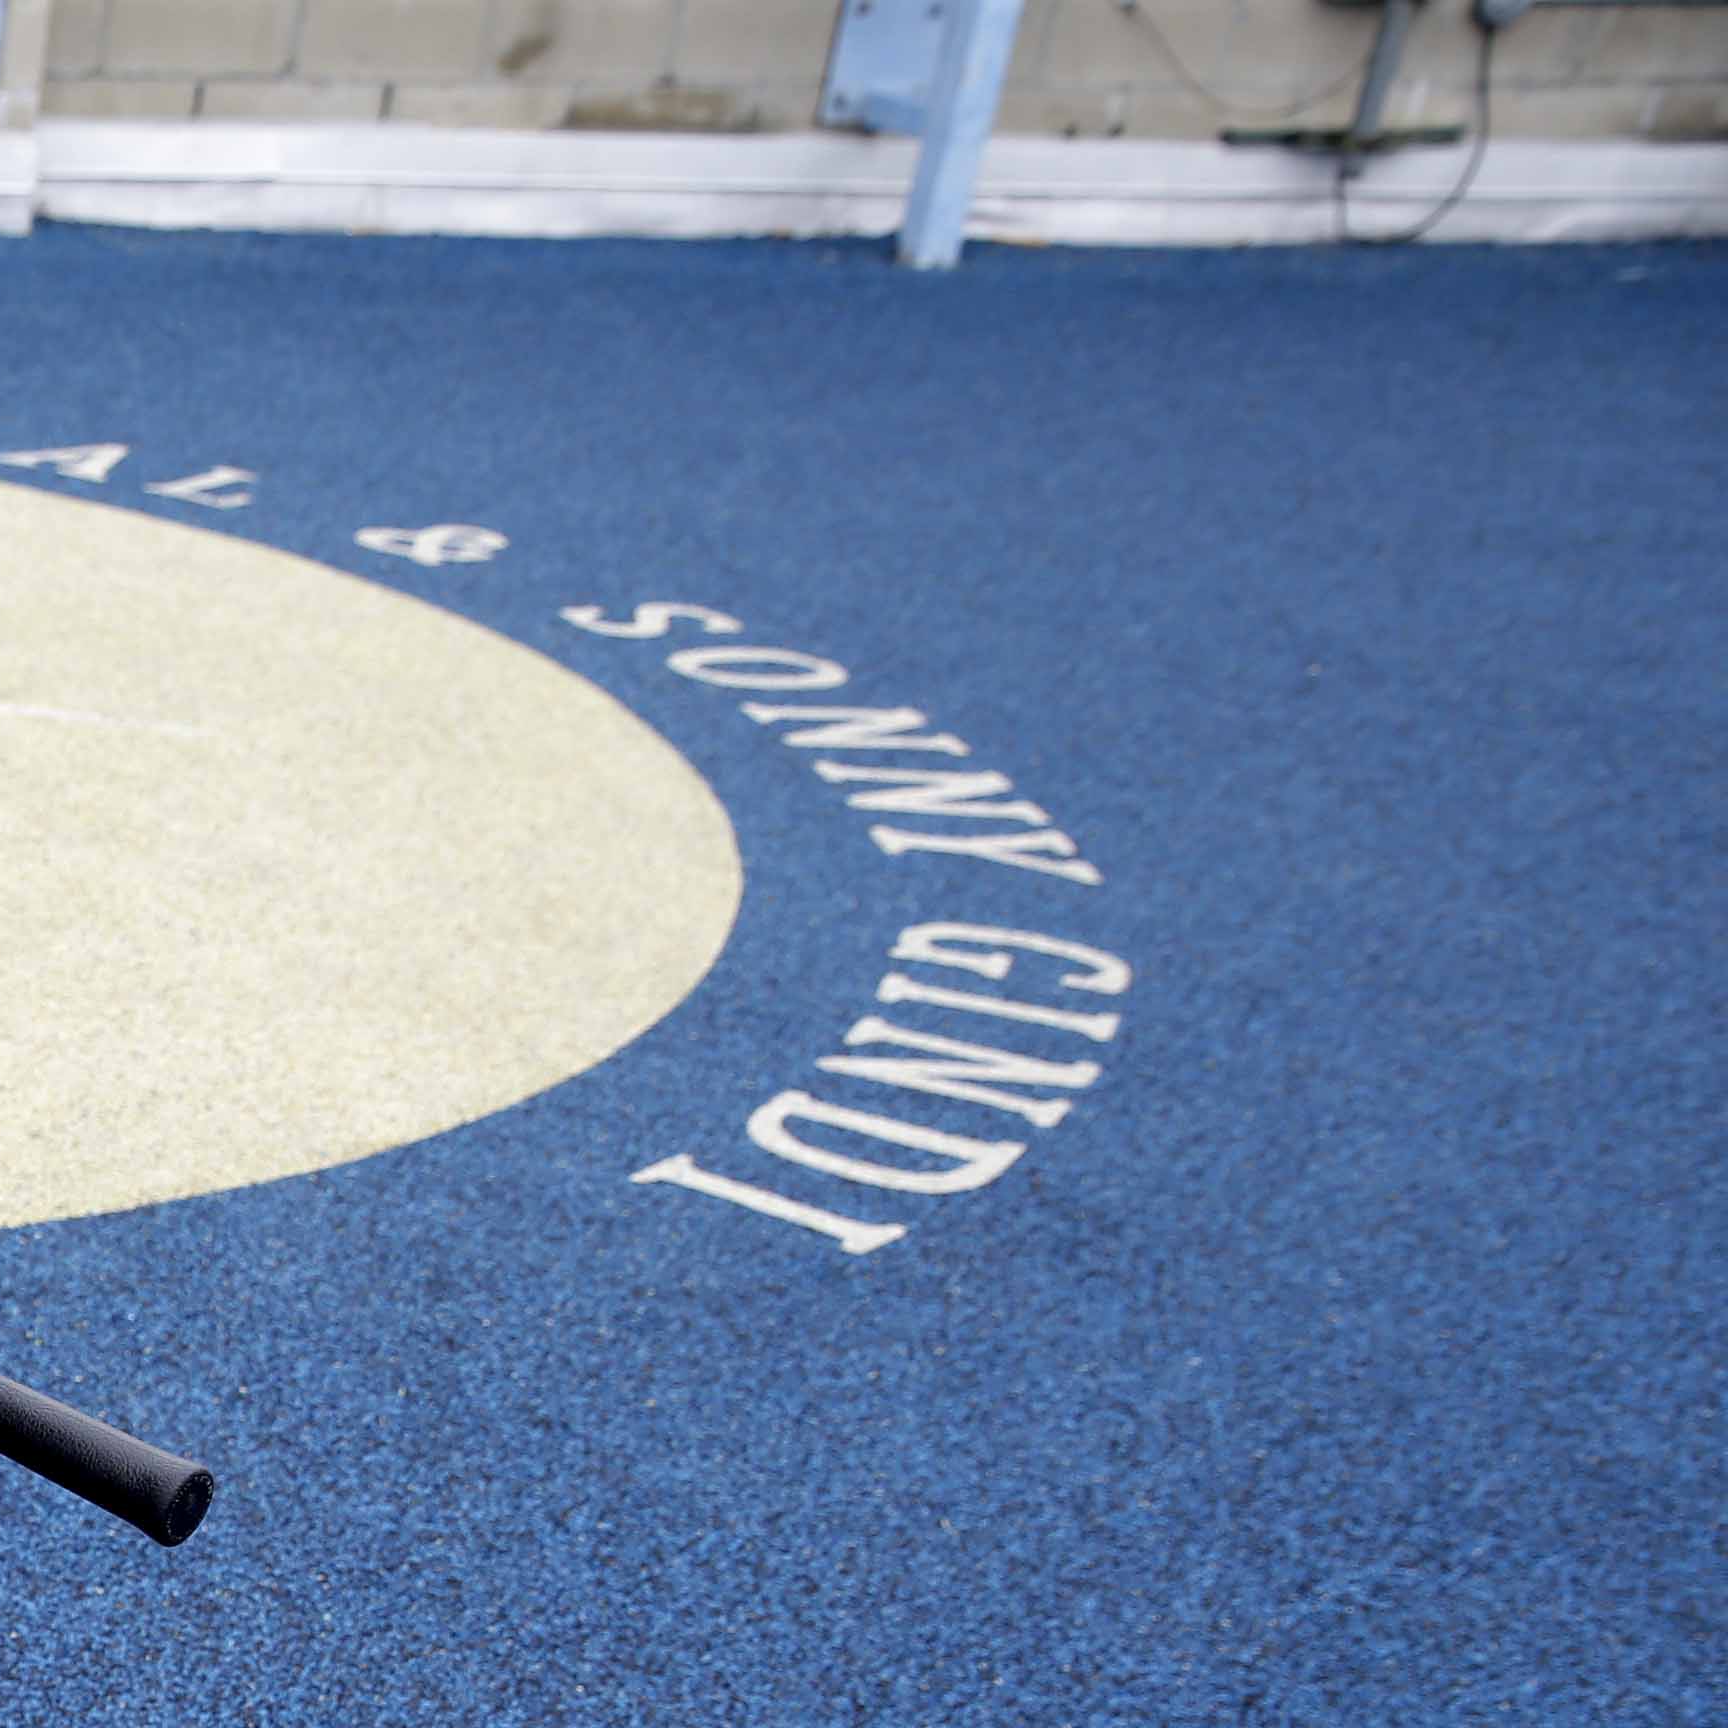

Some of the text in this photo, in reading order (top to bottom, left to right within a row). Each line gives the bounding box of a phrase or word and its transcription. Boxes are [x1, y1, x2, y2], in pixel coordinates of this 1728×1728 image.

[352, 522, 510, 568] &
[559, 600, 1105, 886] SONNY
[629, 920, 1133, 1255] GINDI
